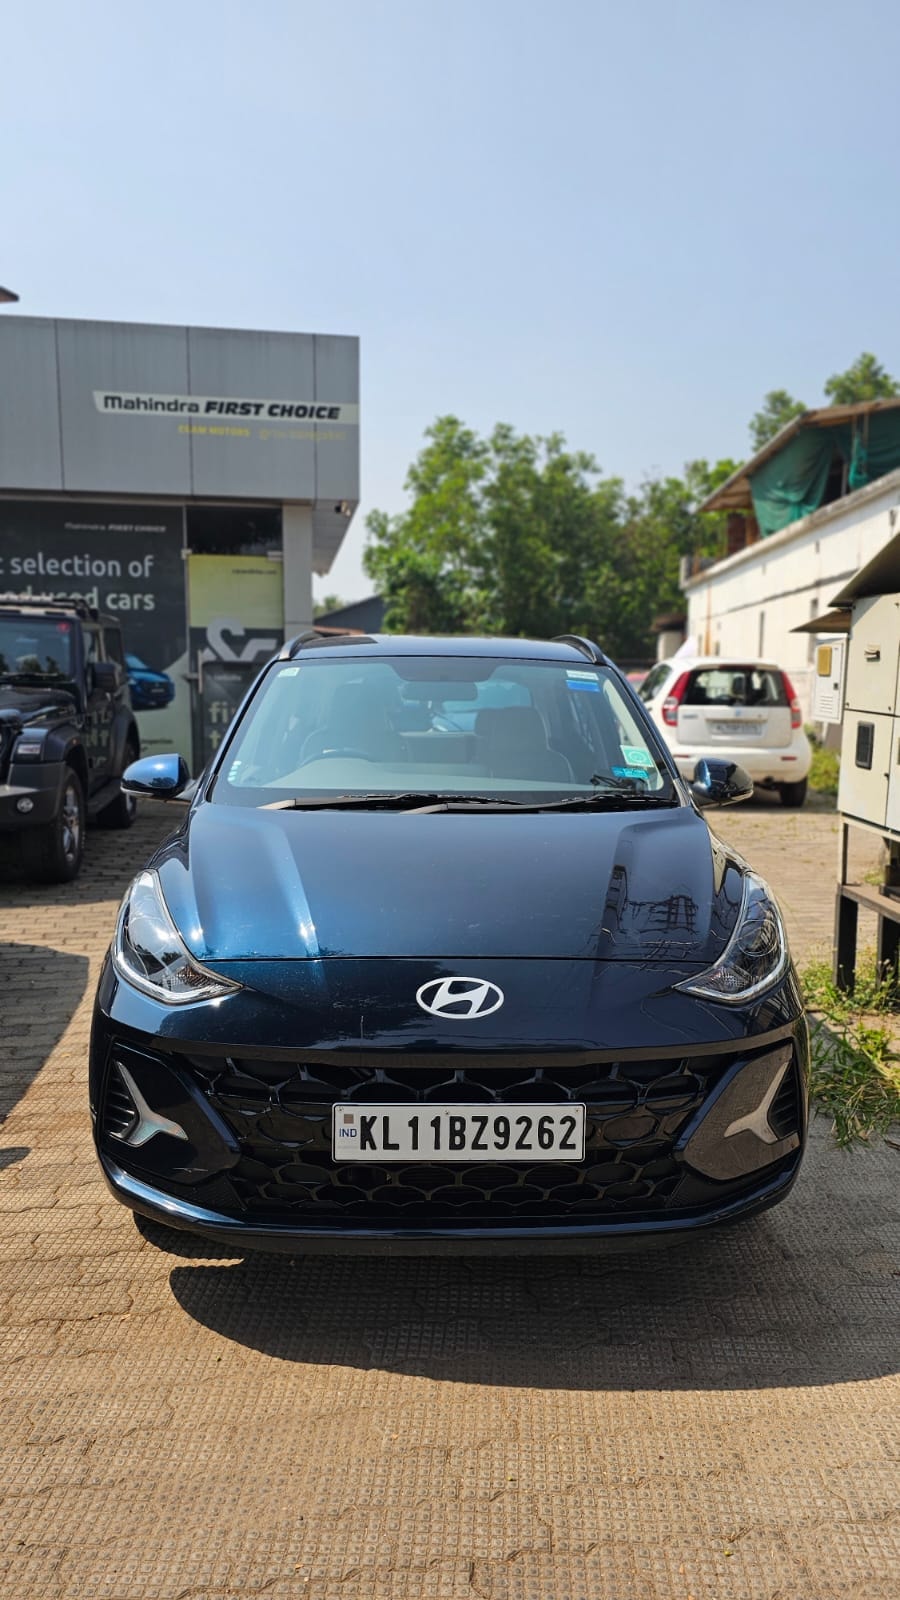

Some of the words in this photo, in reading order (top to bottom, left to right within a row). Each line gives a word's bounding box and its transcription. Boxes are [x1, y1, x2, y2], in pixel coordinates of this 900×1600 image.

[103, 395, 200, 414] Mahindra
[204, 401, 264, 417] FIRST
[267, 403, 341, 420] CHOICE
[10, 552, 121, 577] selection
[128, 555, 154, 577] of
[106, 592, 155, 611] cars
[339, 1128, 358, 1138] IND
[359, 1115, 577, 1151] KL11BZ9262
